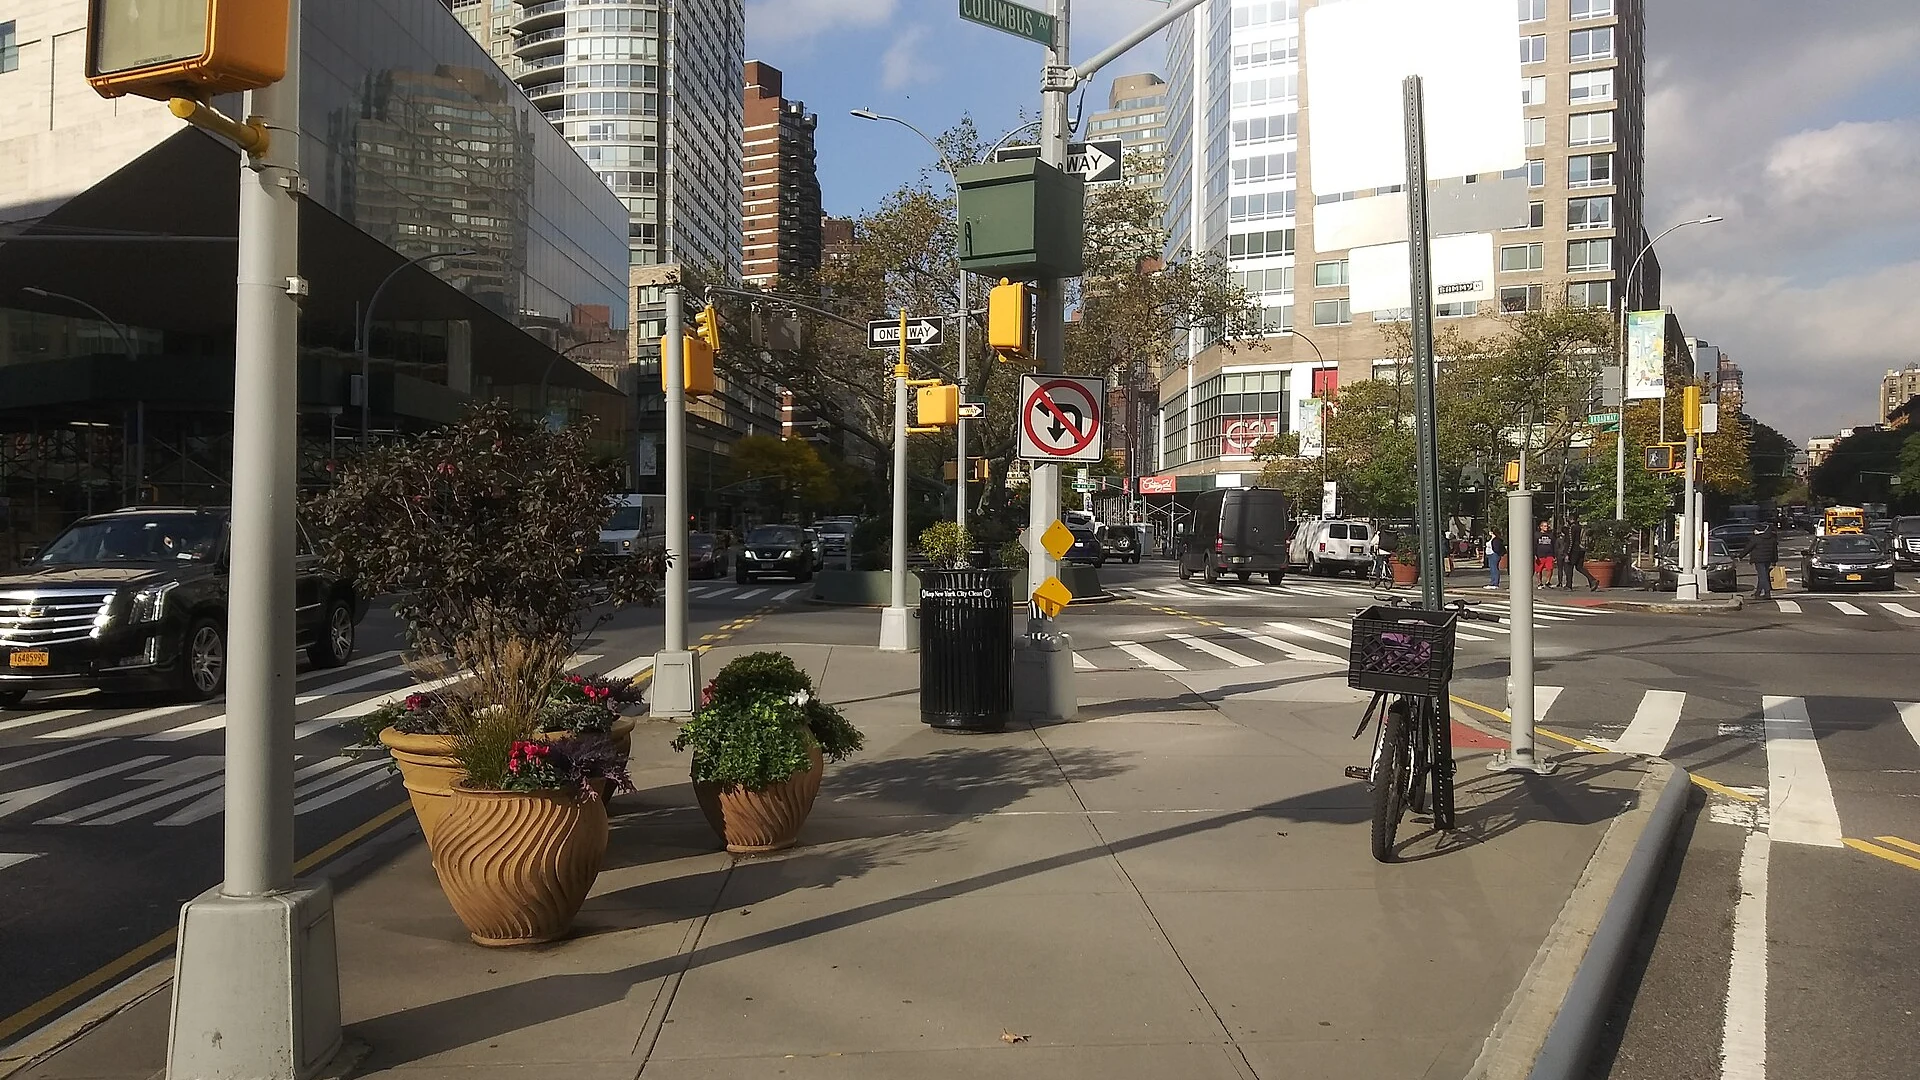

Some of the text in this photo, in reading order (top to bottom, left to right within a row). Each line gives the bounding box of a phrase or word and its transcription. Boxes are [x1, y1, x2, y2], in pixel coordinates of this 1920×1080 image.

[963, 0, 1049, 36] COLUMBUS AV
[1066, 154, 1102, 173] WAY
[879, 326, 931, 339] ONE WAY
[956, 590, 967, 598] City
